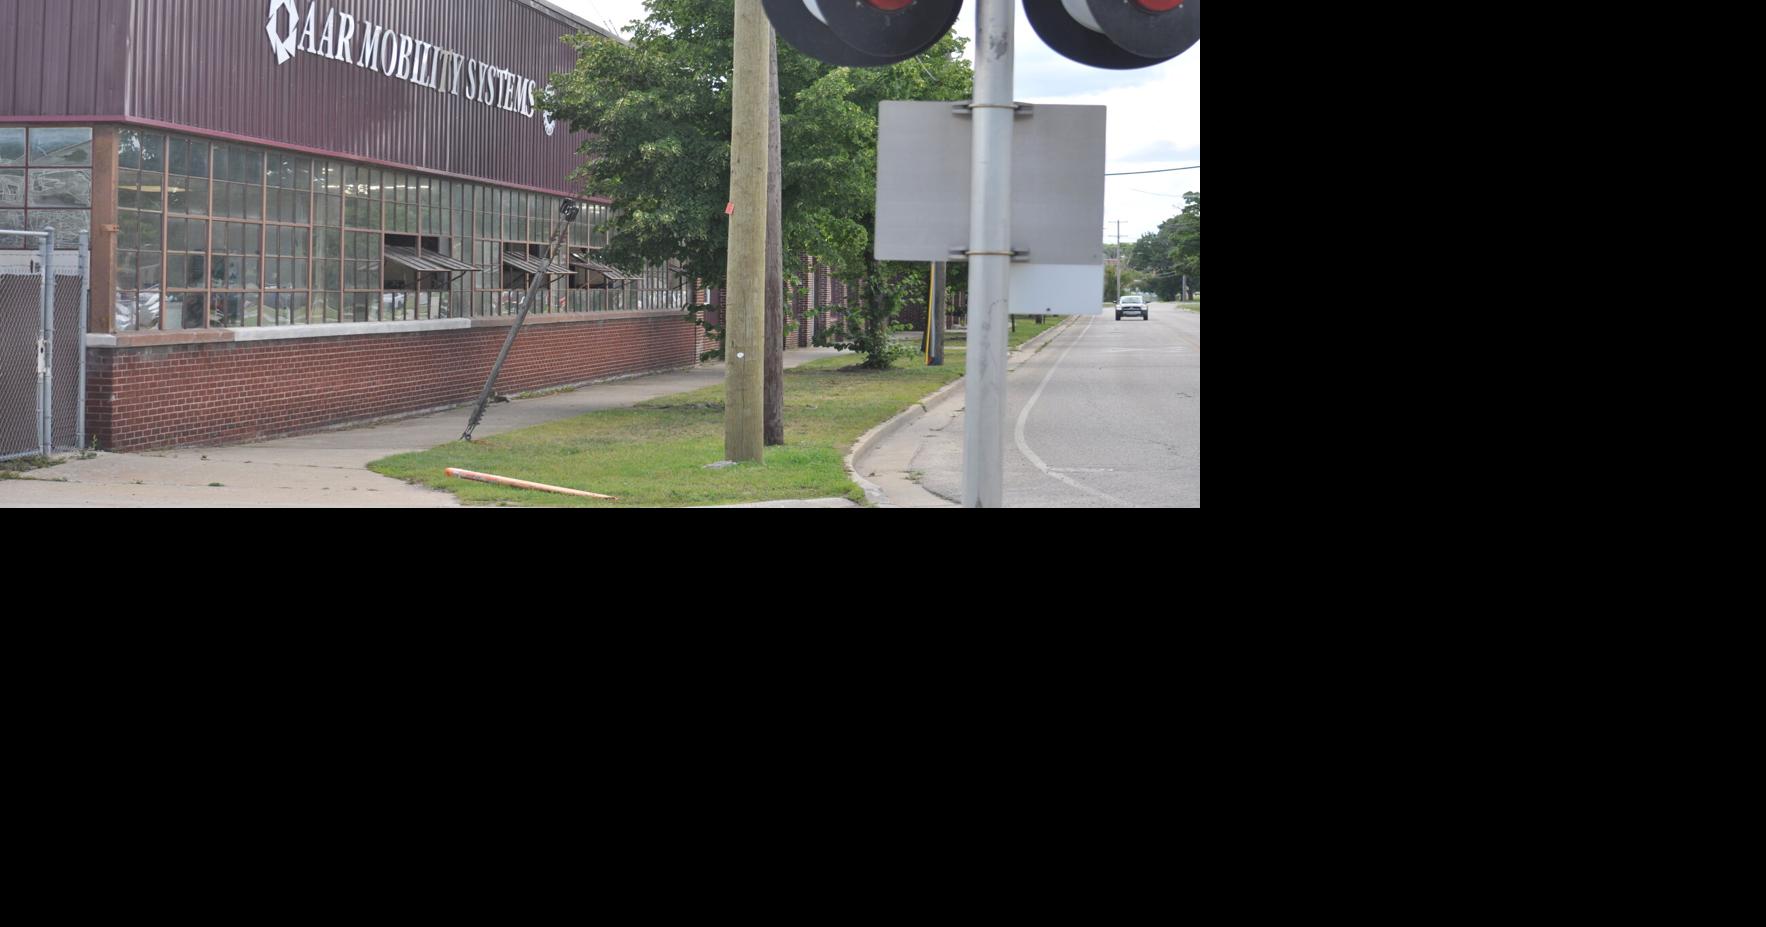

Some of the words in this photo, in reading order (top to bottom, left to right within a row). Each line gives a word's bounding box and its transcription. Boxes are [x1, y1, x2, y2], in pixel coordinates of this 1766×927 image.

[297, 2, 355, 64] AAR
[357, 20, 464, 95] MOBILITY
[465, 58, 535, 118] SYSTEMS
